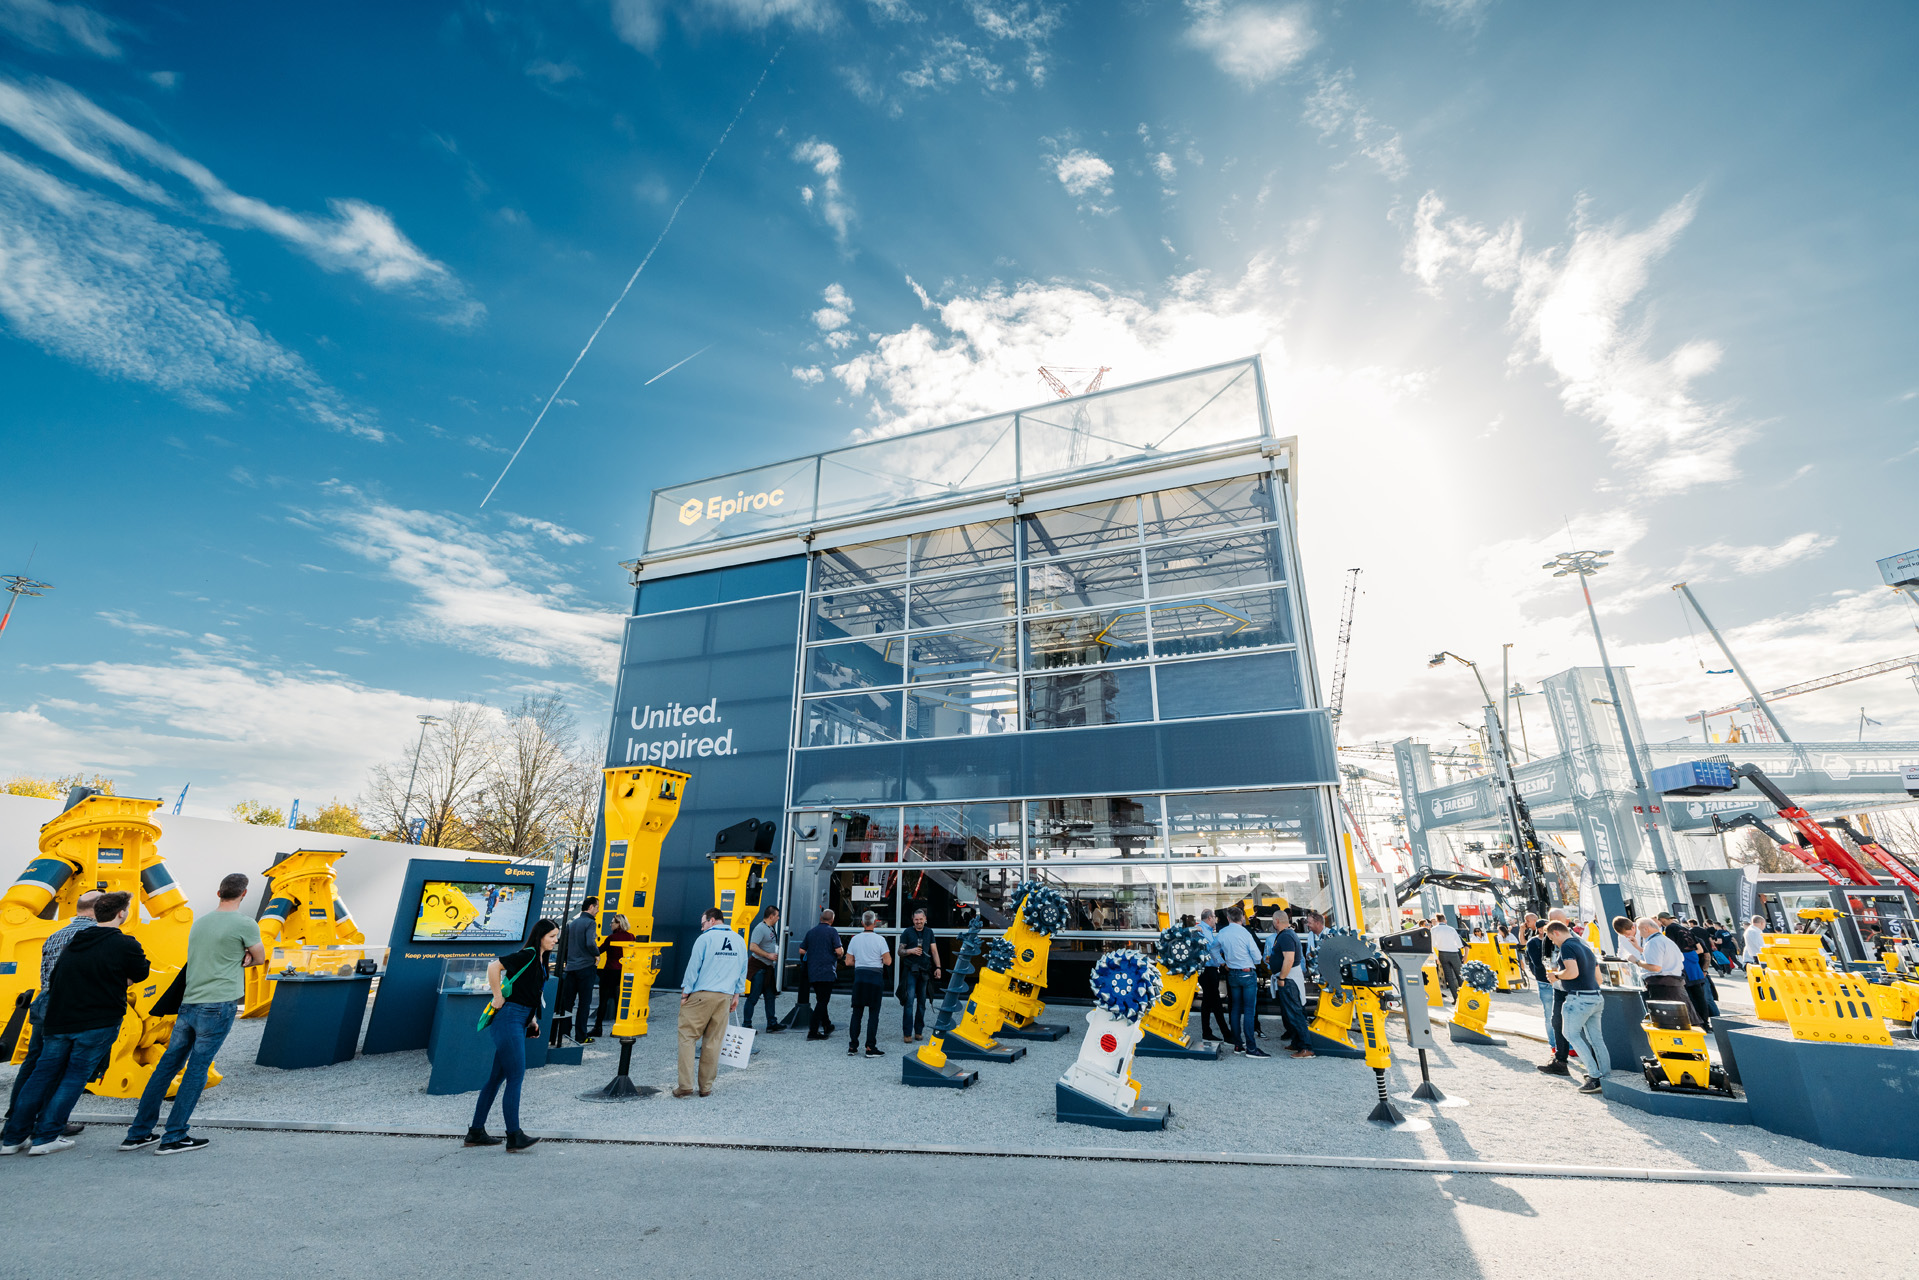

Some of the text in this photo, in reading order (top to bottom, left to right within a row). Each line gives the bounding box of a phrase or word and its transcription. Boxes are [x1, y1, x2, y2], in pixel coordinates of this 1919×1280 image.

[706, 489, 784, 522] Epiroc
[631, 698, 722, 730] United.
[626, 726, 739, 765] Inspired.
[1562, 698, 1587, 769] FARESIN
[1443, 795, 1475, 811] FARESIN
[513, 868, 535, 877] Epiroc
[1742, 882, 1751, 916] FARESIN
[144, 988, 156, 996] New
